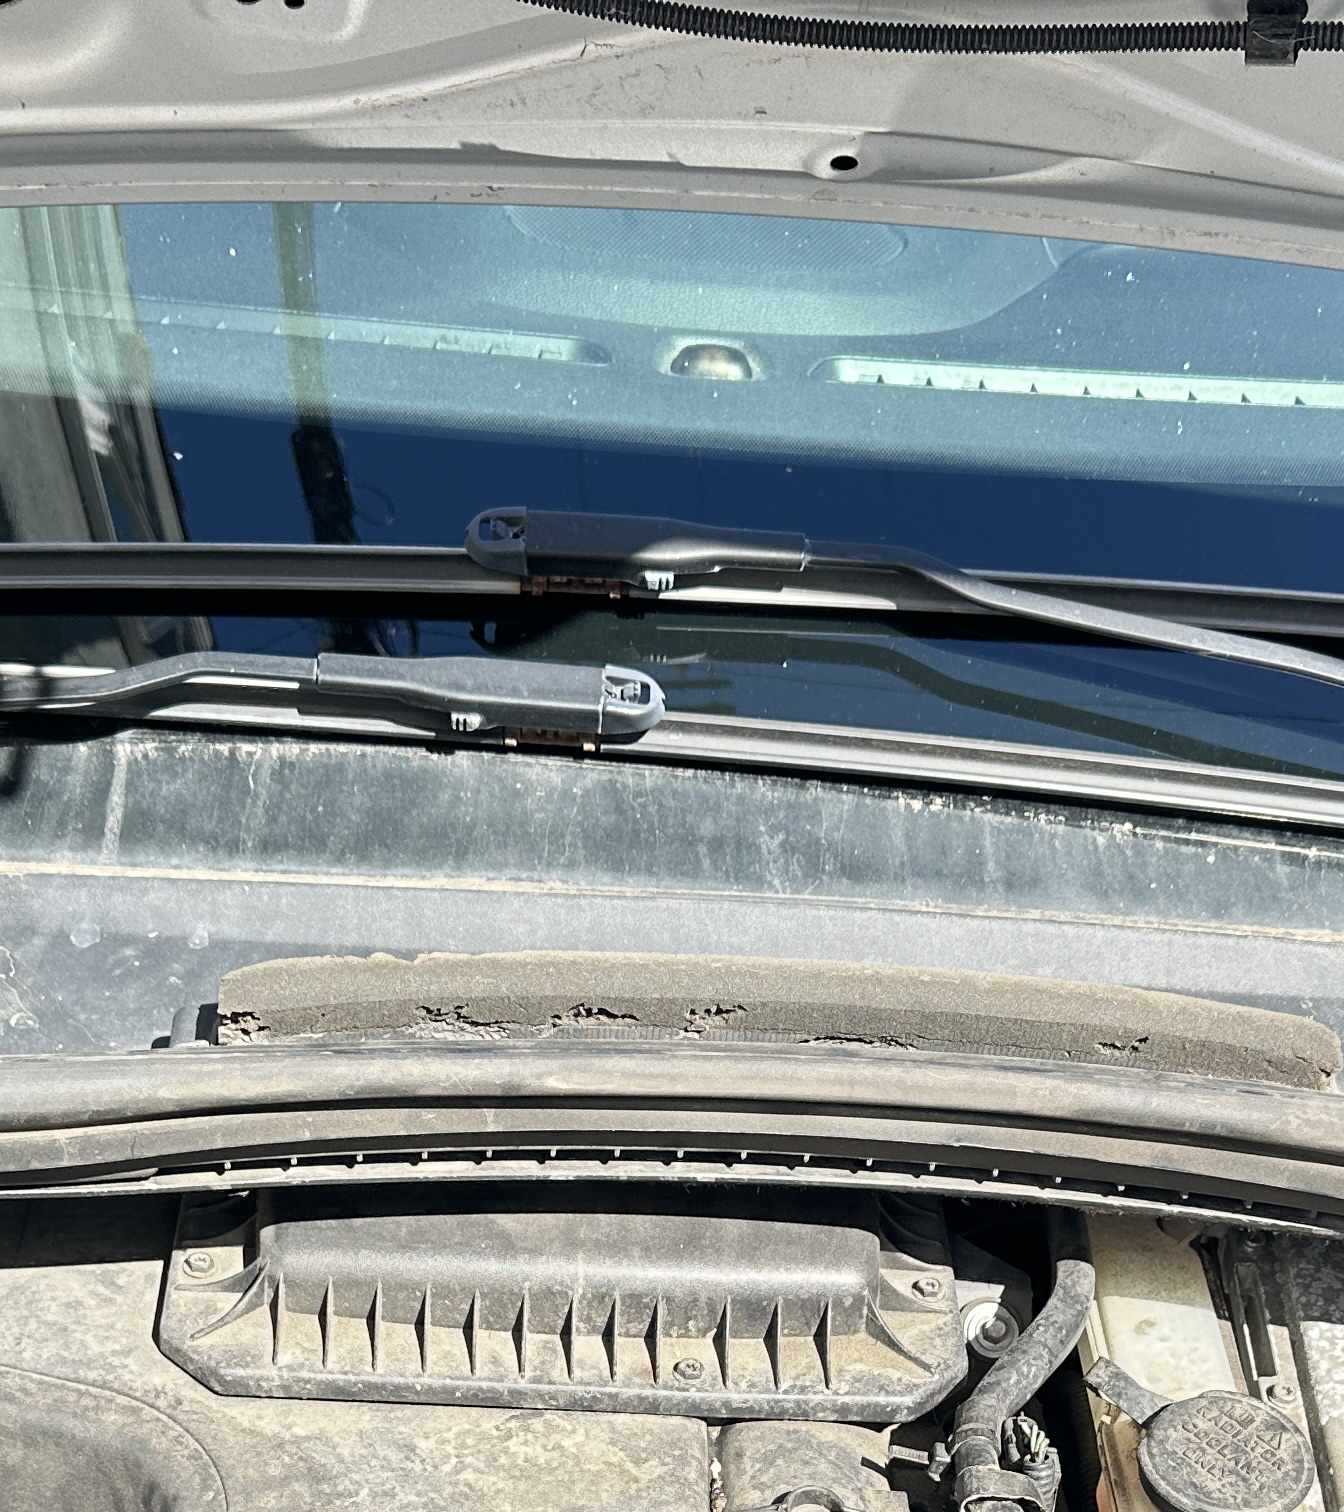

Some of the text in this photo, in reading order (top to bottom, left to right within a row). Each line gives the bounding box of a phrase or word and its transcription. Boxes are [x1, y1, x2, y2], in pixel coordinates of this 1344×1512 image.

[1182, 1421, 1268, 1482] COOLANT
[1182, 1447, 1232, 1479] ONLY
[1197, 1404, 1287, 1471] RADIATOR
